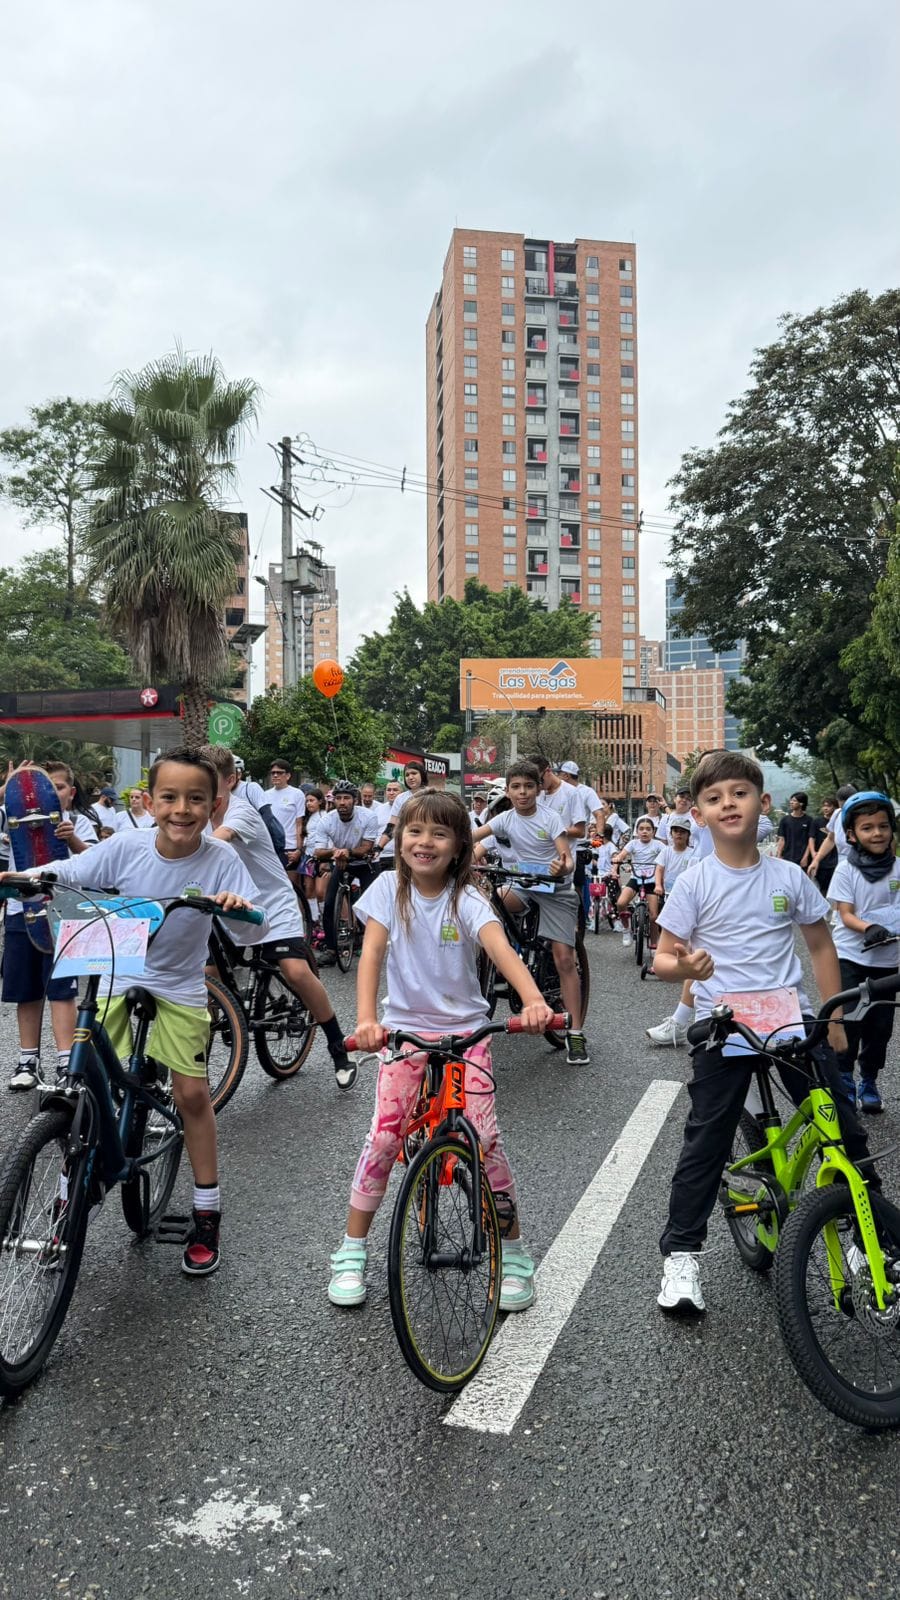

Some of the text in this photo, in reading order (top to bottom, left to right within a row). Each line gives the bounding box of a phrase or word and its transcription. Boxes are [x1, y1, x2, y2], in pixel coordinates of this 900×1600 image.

[500, 674, 577, 692] Las Vegas
[492, 692, 530, 700] Tranquilidad
[424, 758, 447, 775] TEXACO
